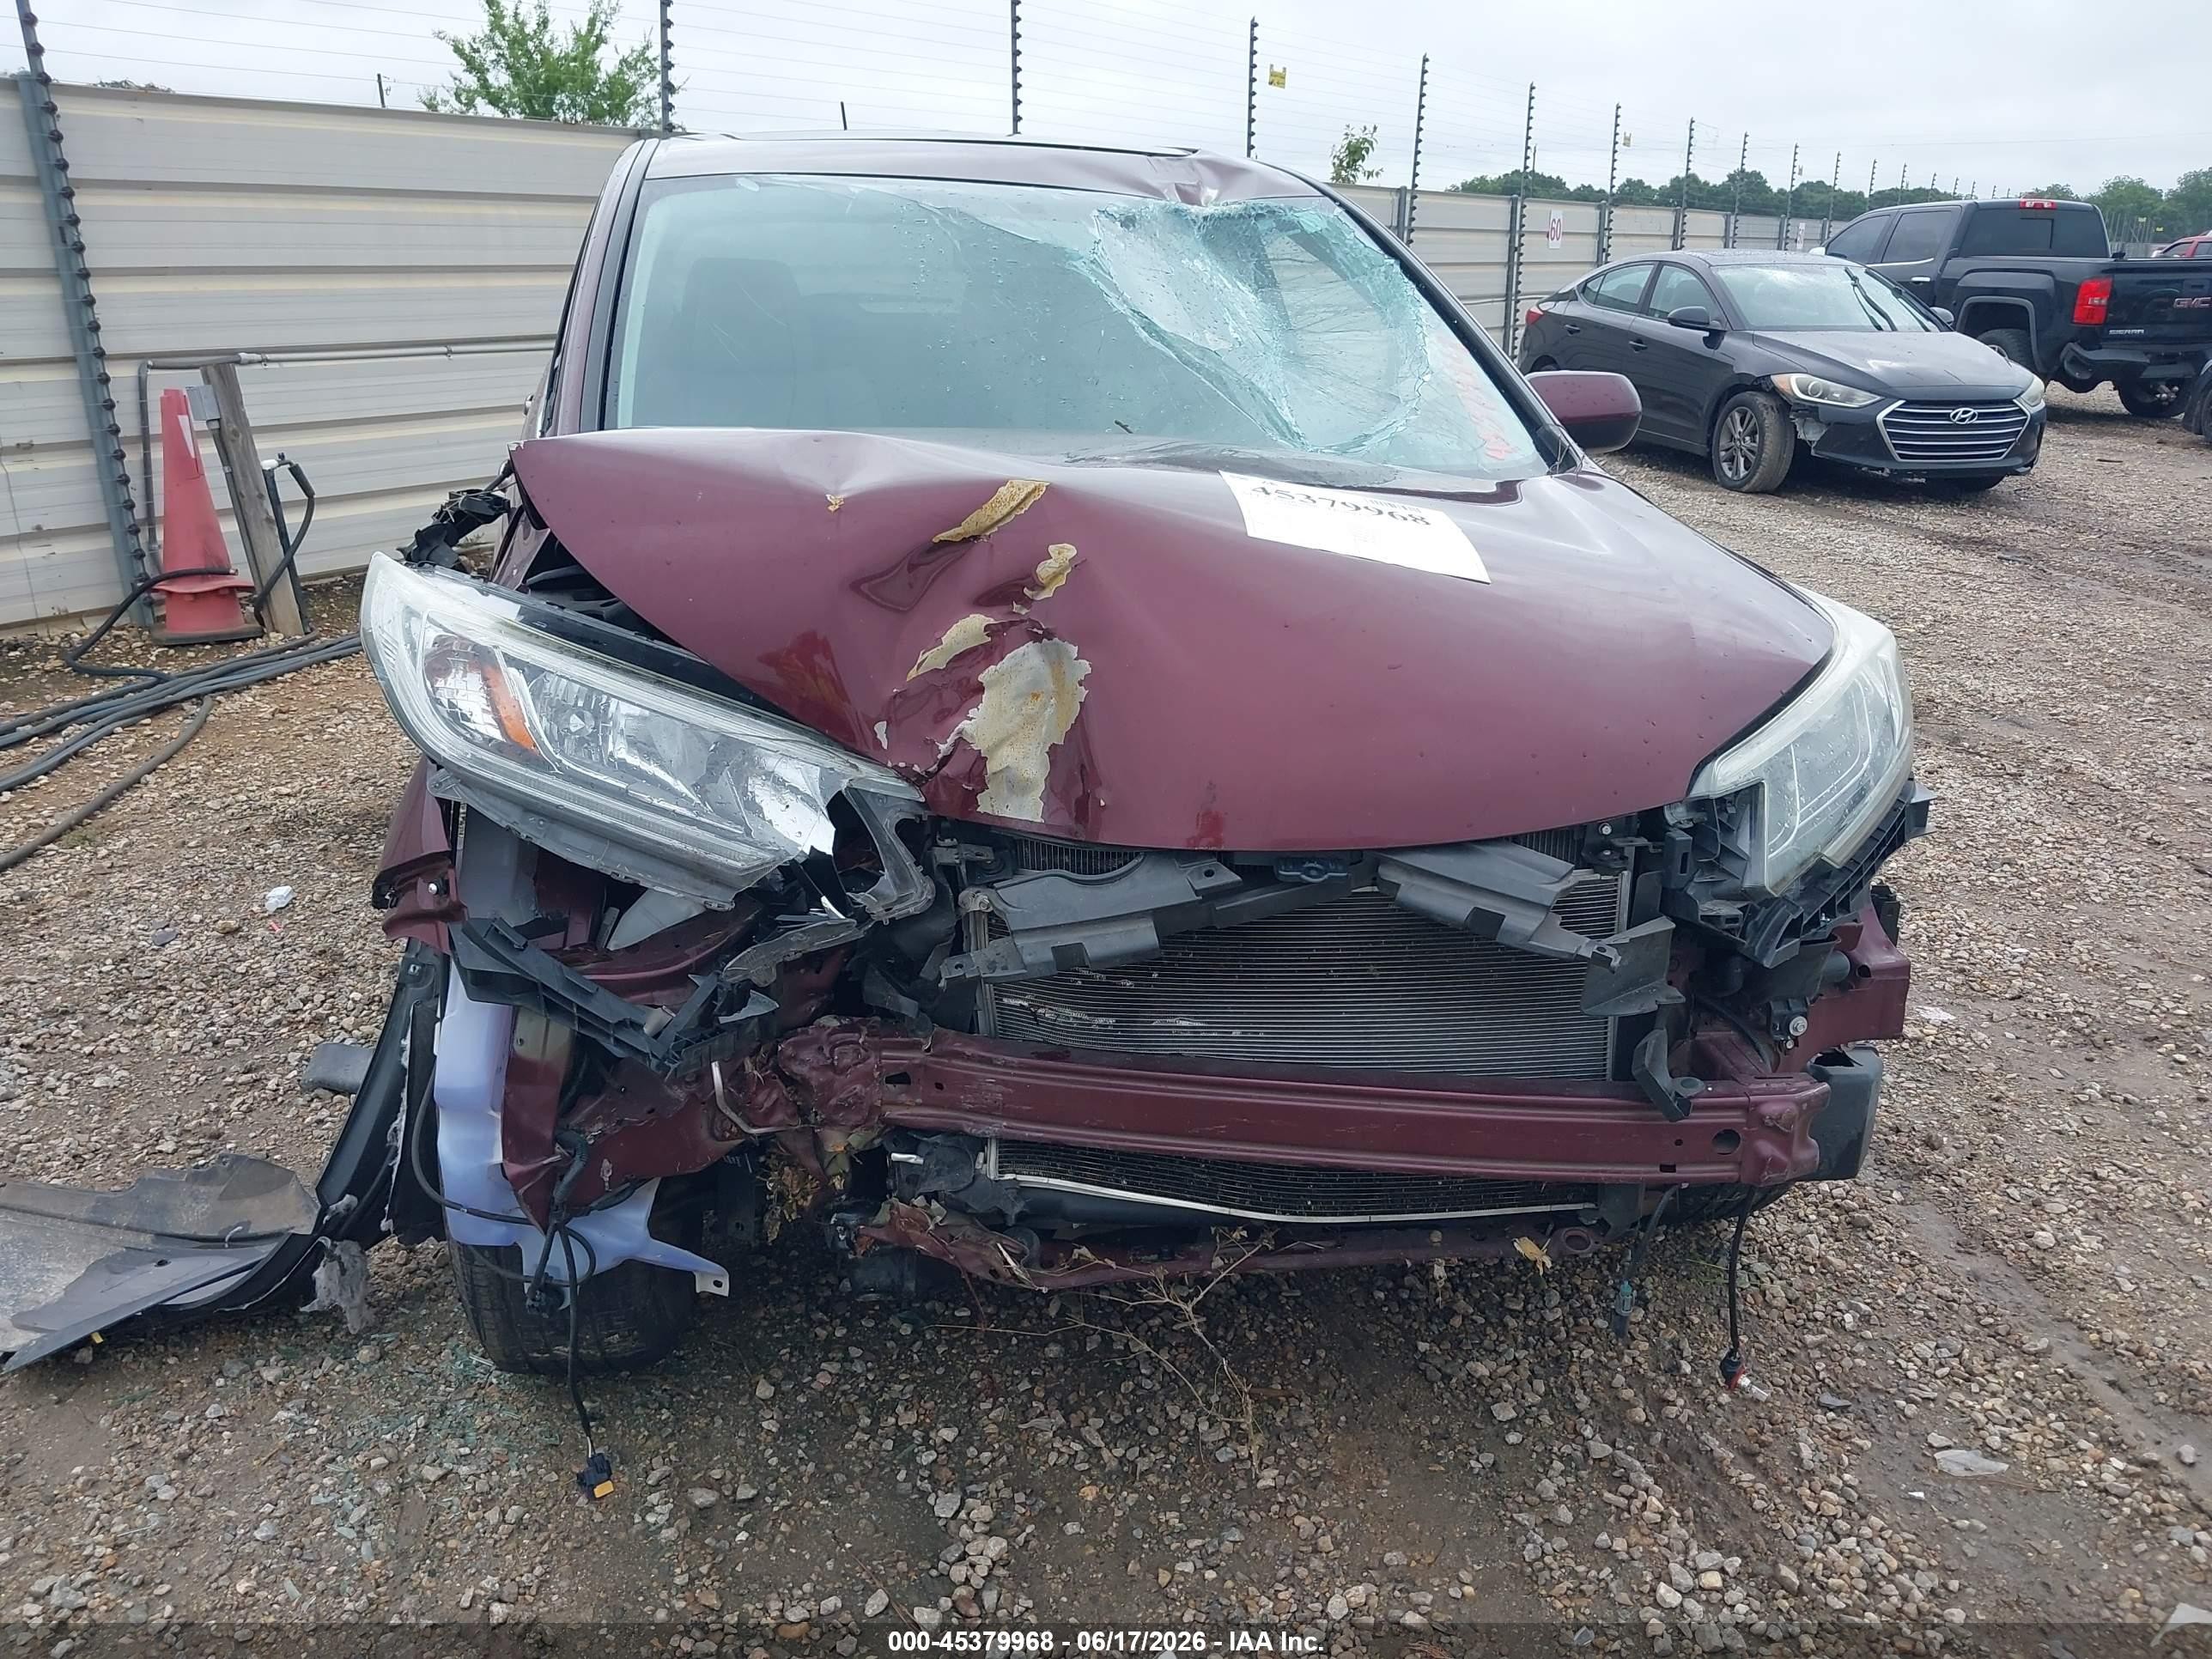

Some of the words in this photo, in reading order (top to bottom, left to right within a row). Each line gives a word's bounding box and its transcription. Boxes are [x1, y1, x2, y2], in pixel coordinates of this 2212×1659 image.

[1550, 218, 1561, 241] 60
[2174, 297, 2212, 309] GMC
[1251, 485, 1431, 526] 45379968
